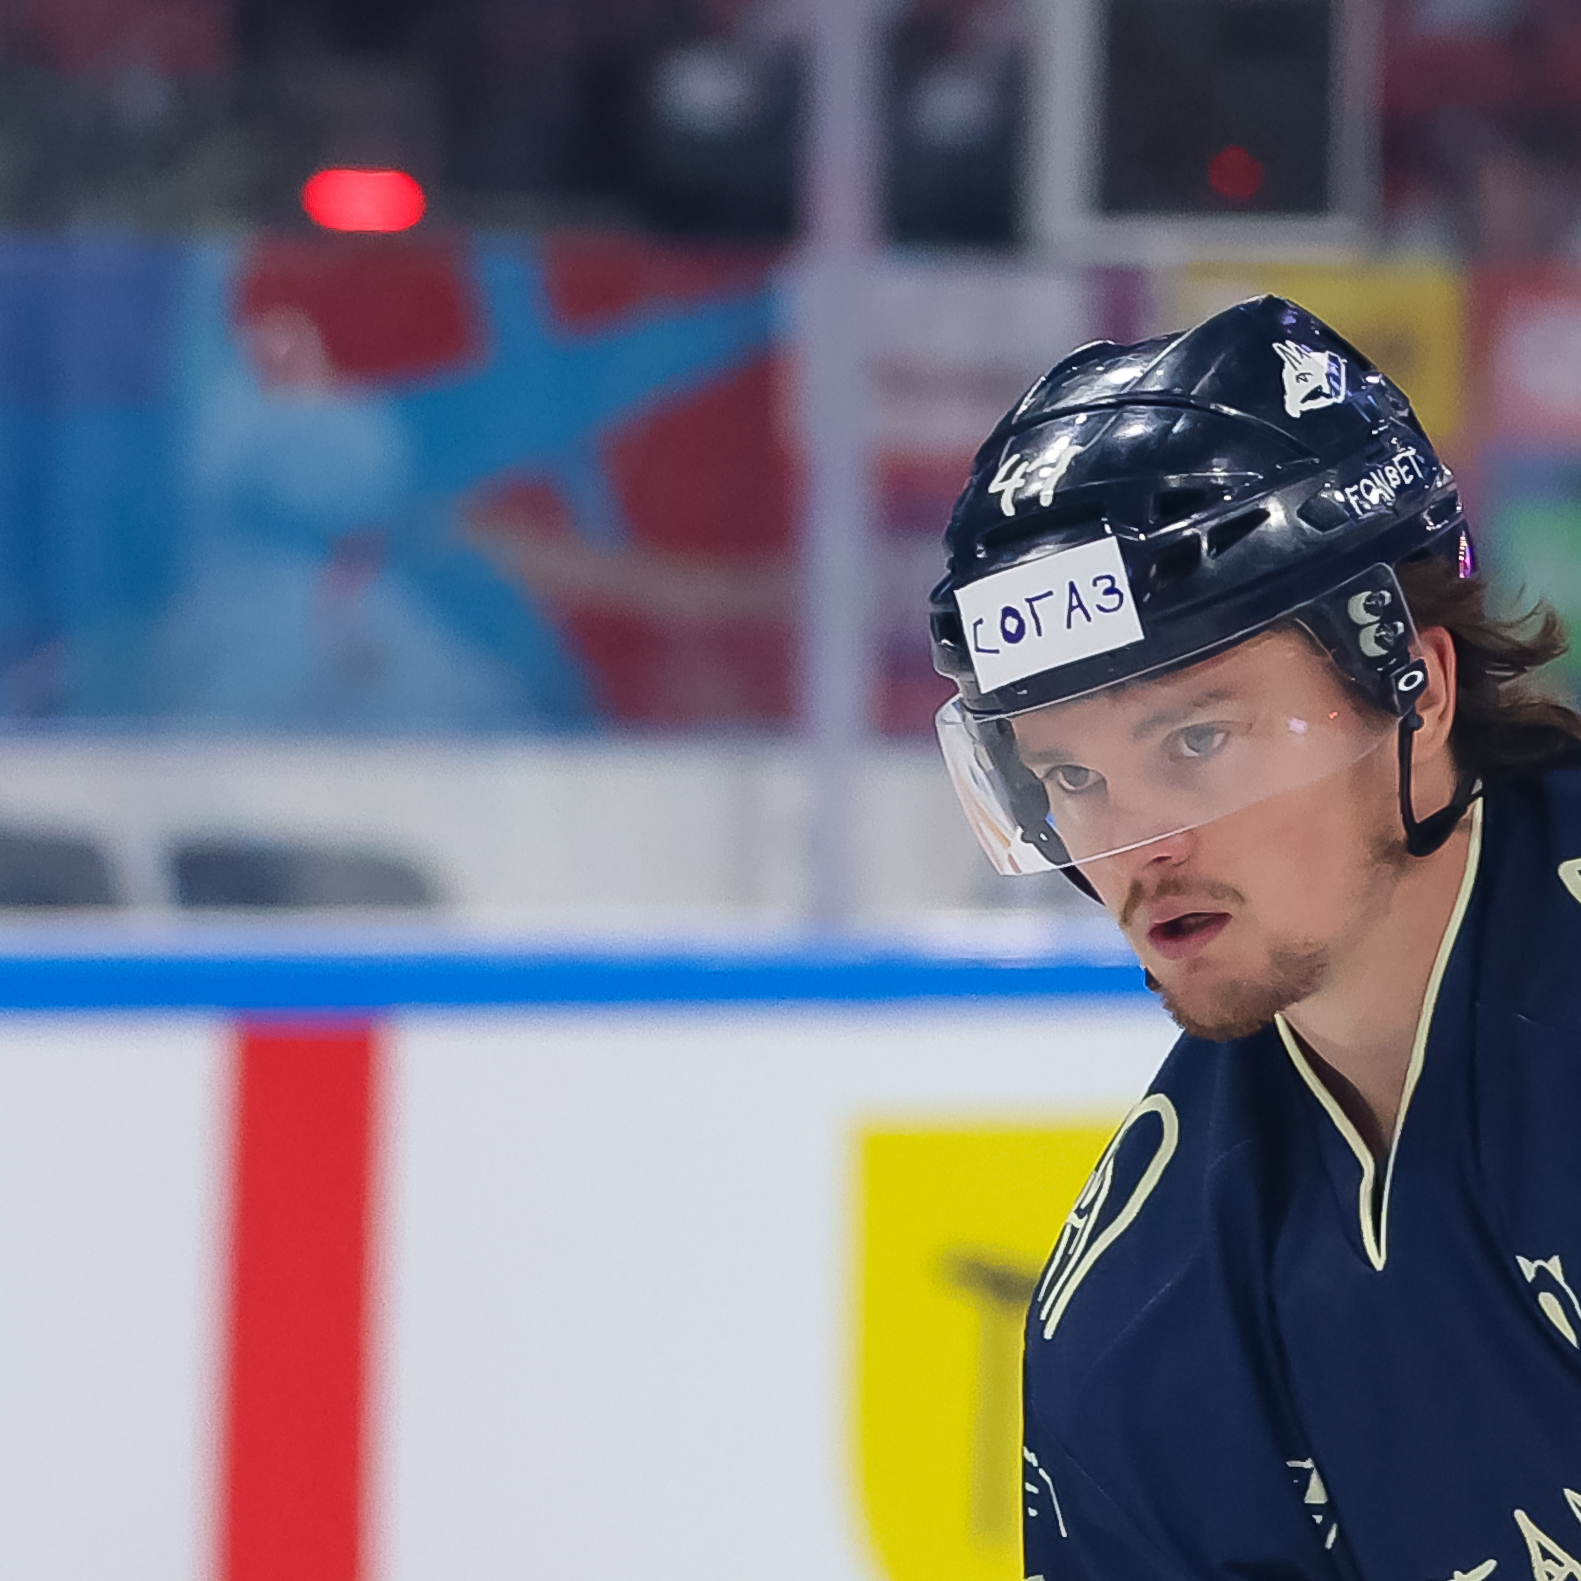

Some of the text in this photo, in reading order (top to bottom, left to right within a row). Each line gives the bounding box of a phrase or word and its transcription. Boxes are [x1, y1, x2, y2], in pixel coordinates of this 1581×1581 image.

[988, 444, 1085, 517] 47
[1343, 446, 1424, 518] FONBET
[972, 574, 1124, 655] СОГАЗ
